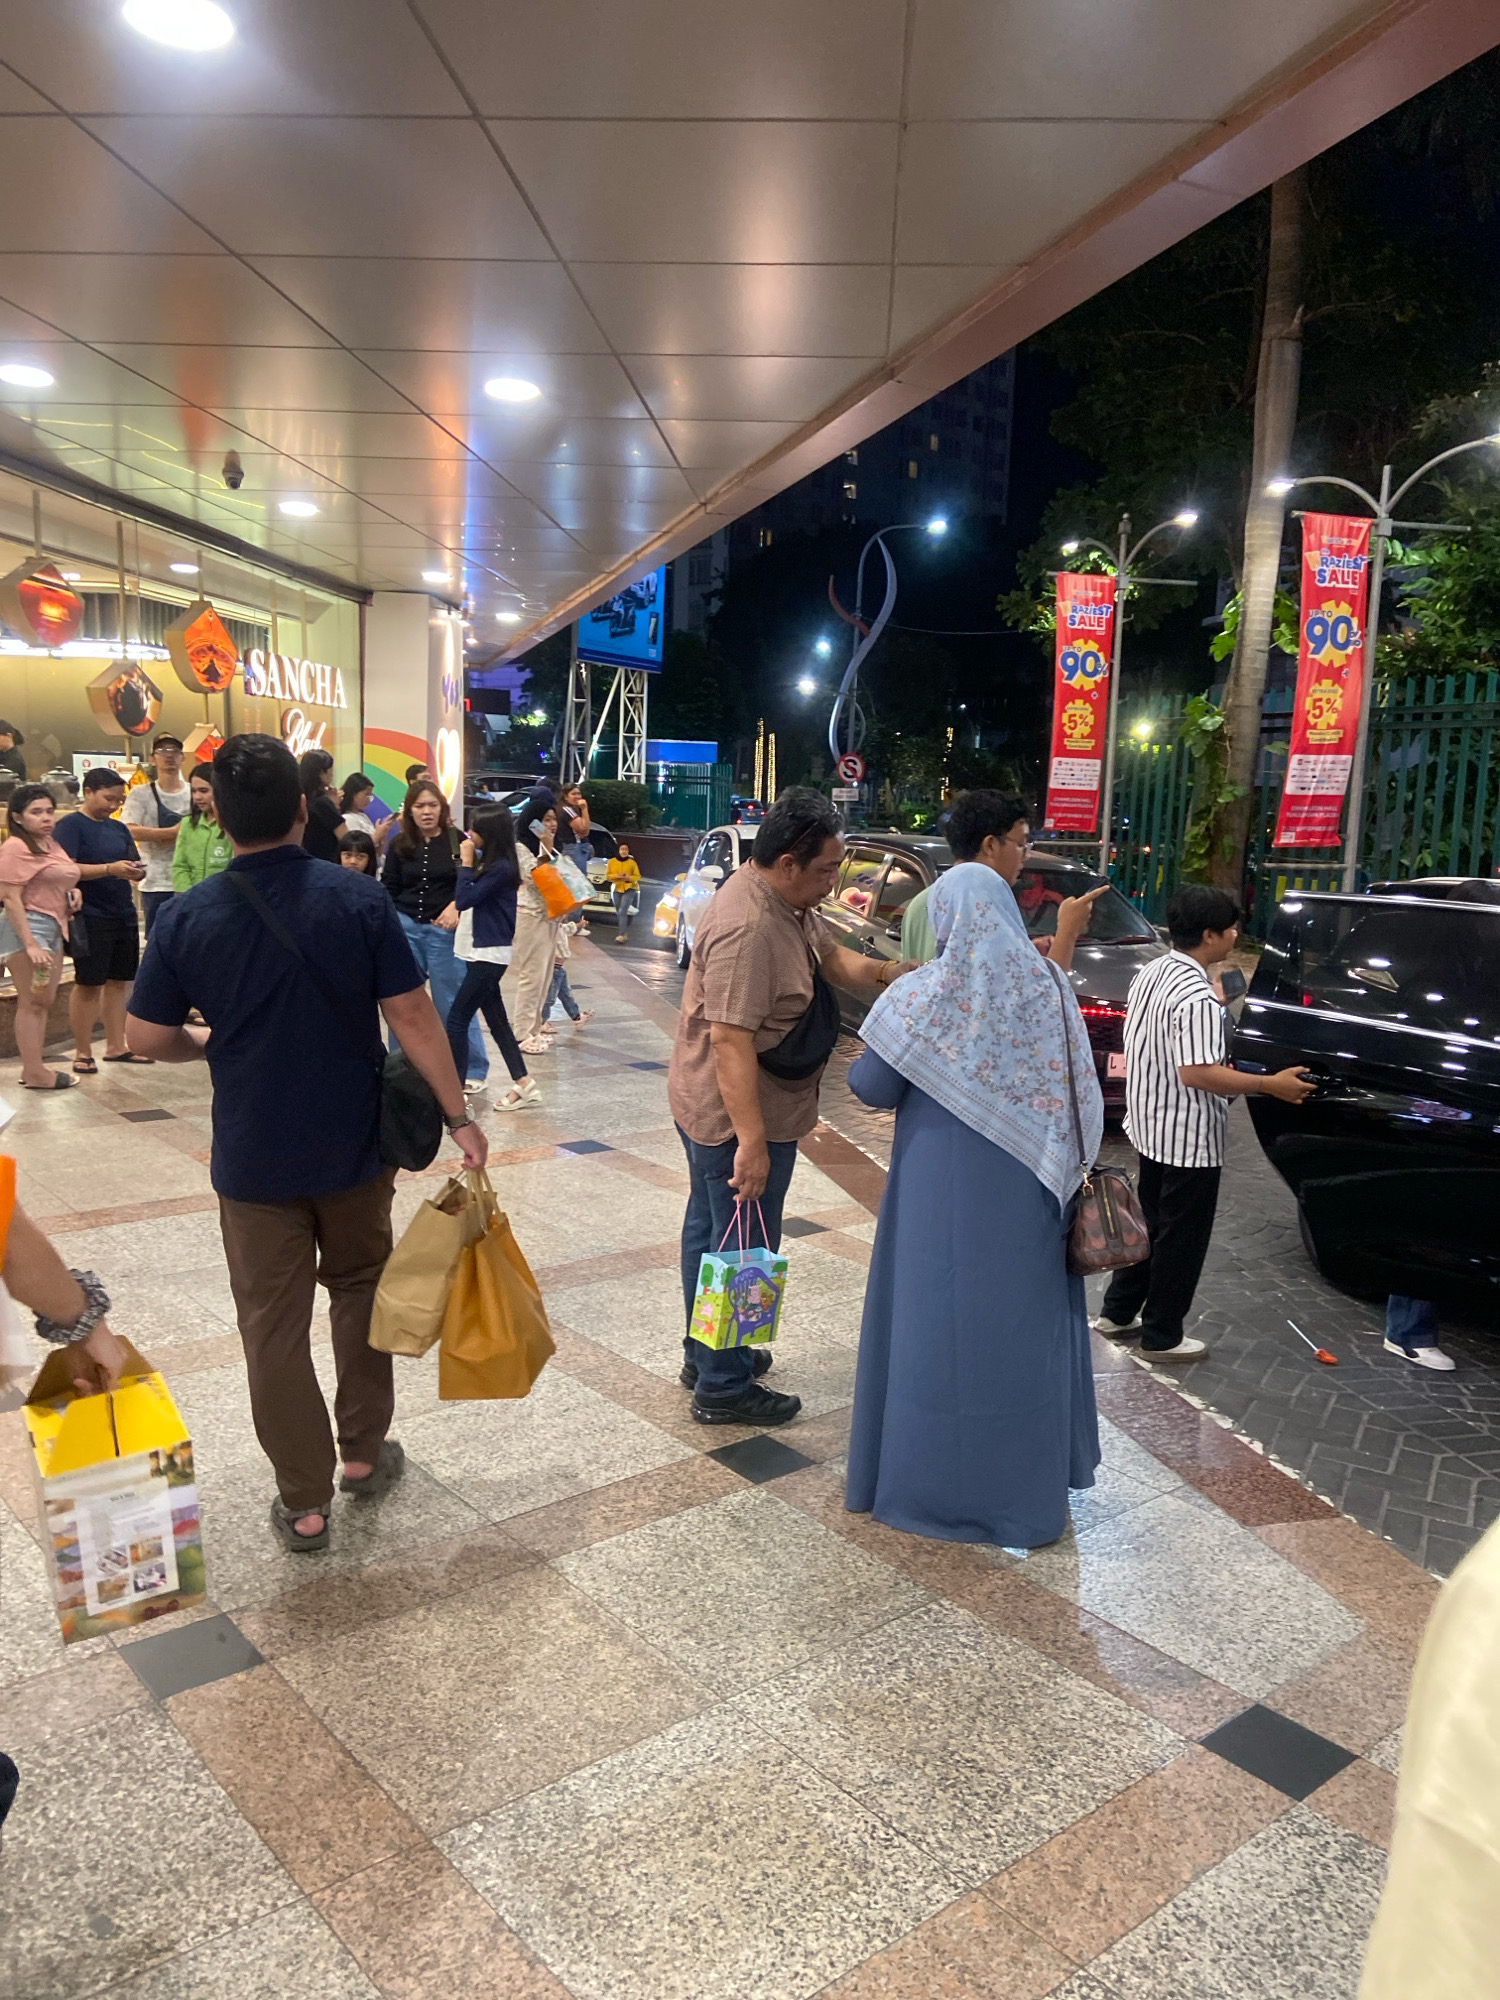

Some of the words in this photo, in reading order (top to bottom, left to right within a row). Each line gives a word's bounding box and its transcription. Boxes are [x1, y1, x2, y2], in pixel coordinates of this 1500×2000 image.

[1316, 568, 1360, 586] SALE
[1068, 614, 1106, 628] SALE
[1305, 615, 1363, 655] 90%
[1060, 651, 1109, 681] 90%
[248, 648, 348, 708] SANCHA
[1312, 698, 1338, 719] 5%
[1068, 713, 1089, 730] 5%
